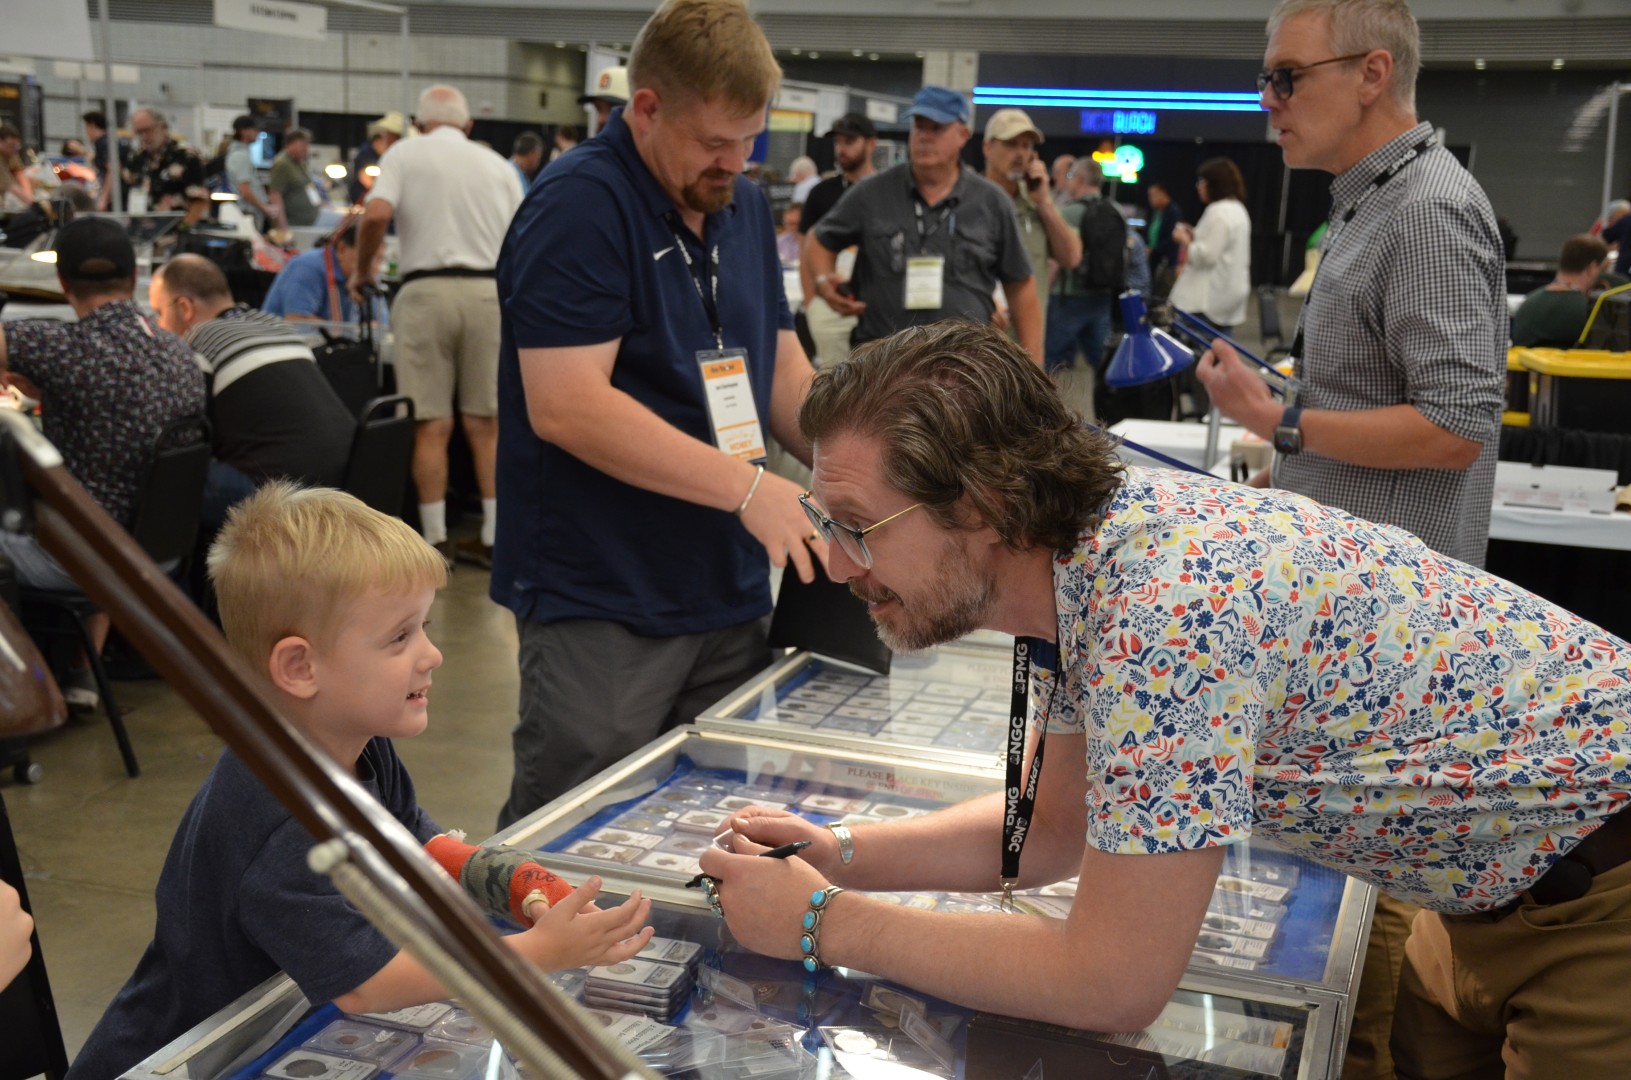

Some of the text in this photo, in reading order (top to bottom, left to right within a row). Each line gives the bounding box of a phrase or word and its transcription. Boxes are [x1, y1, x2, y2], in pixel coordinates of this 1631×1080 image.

[1392, 148, 1417, 170] PMG
[1015, 643, 1028, 683] PMG
[1010, 716, 1024, 754] NGC
[847, 767, 884, 780] PLEASE
[921, 776, 941, 788] KEY
[943, 781, 977, 793] INSIDE
[1026, 764, 1039, 800] PMG
[1008, 823, 1026, 853] NGC
